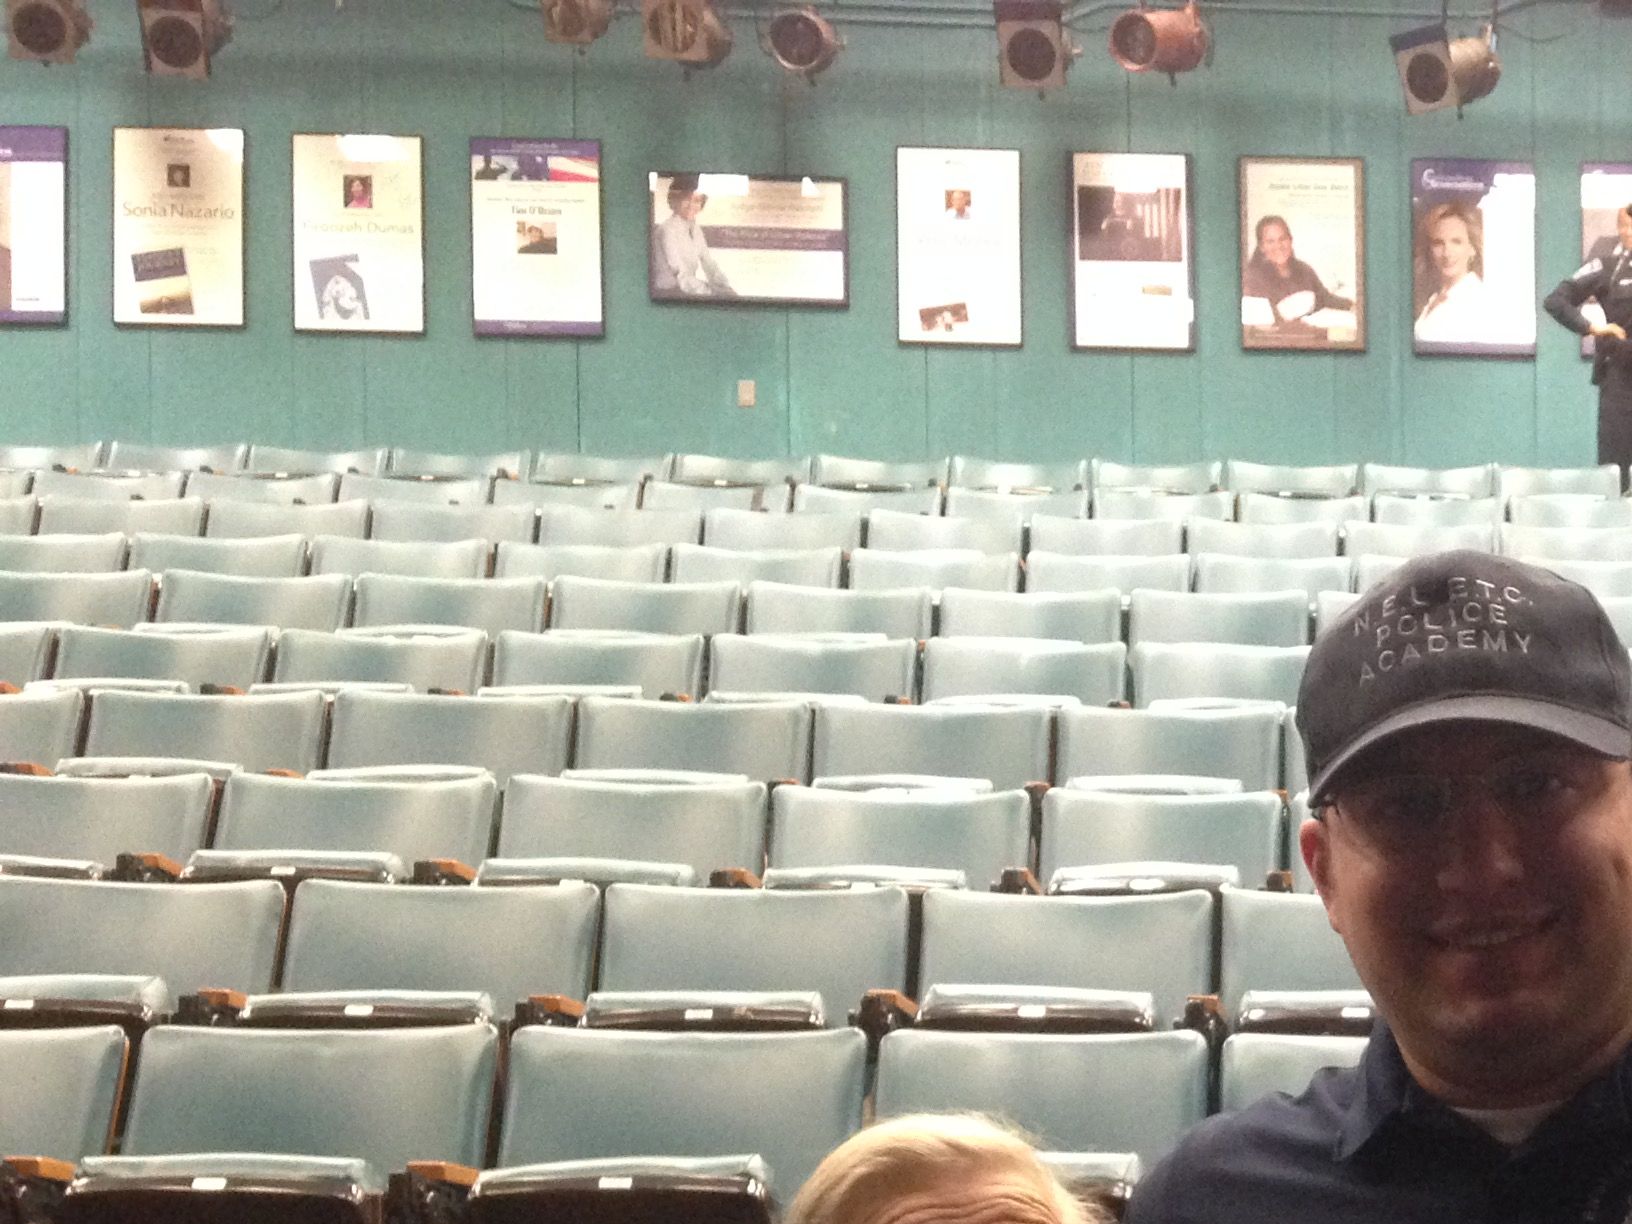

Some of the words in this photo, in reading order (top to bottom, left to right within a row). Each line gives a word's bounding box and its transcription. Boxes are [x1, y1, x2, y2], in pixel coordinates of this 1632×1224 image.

[122, 201, 168, 217] Sonia
[170, 202, 235, 219] Nazario
[1376, 602, 1508, 648] POLICE
[1359, 629, 1532, 687] ACADEMY
